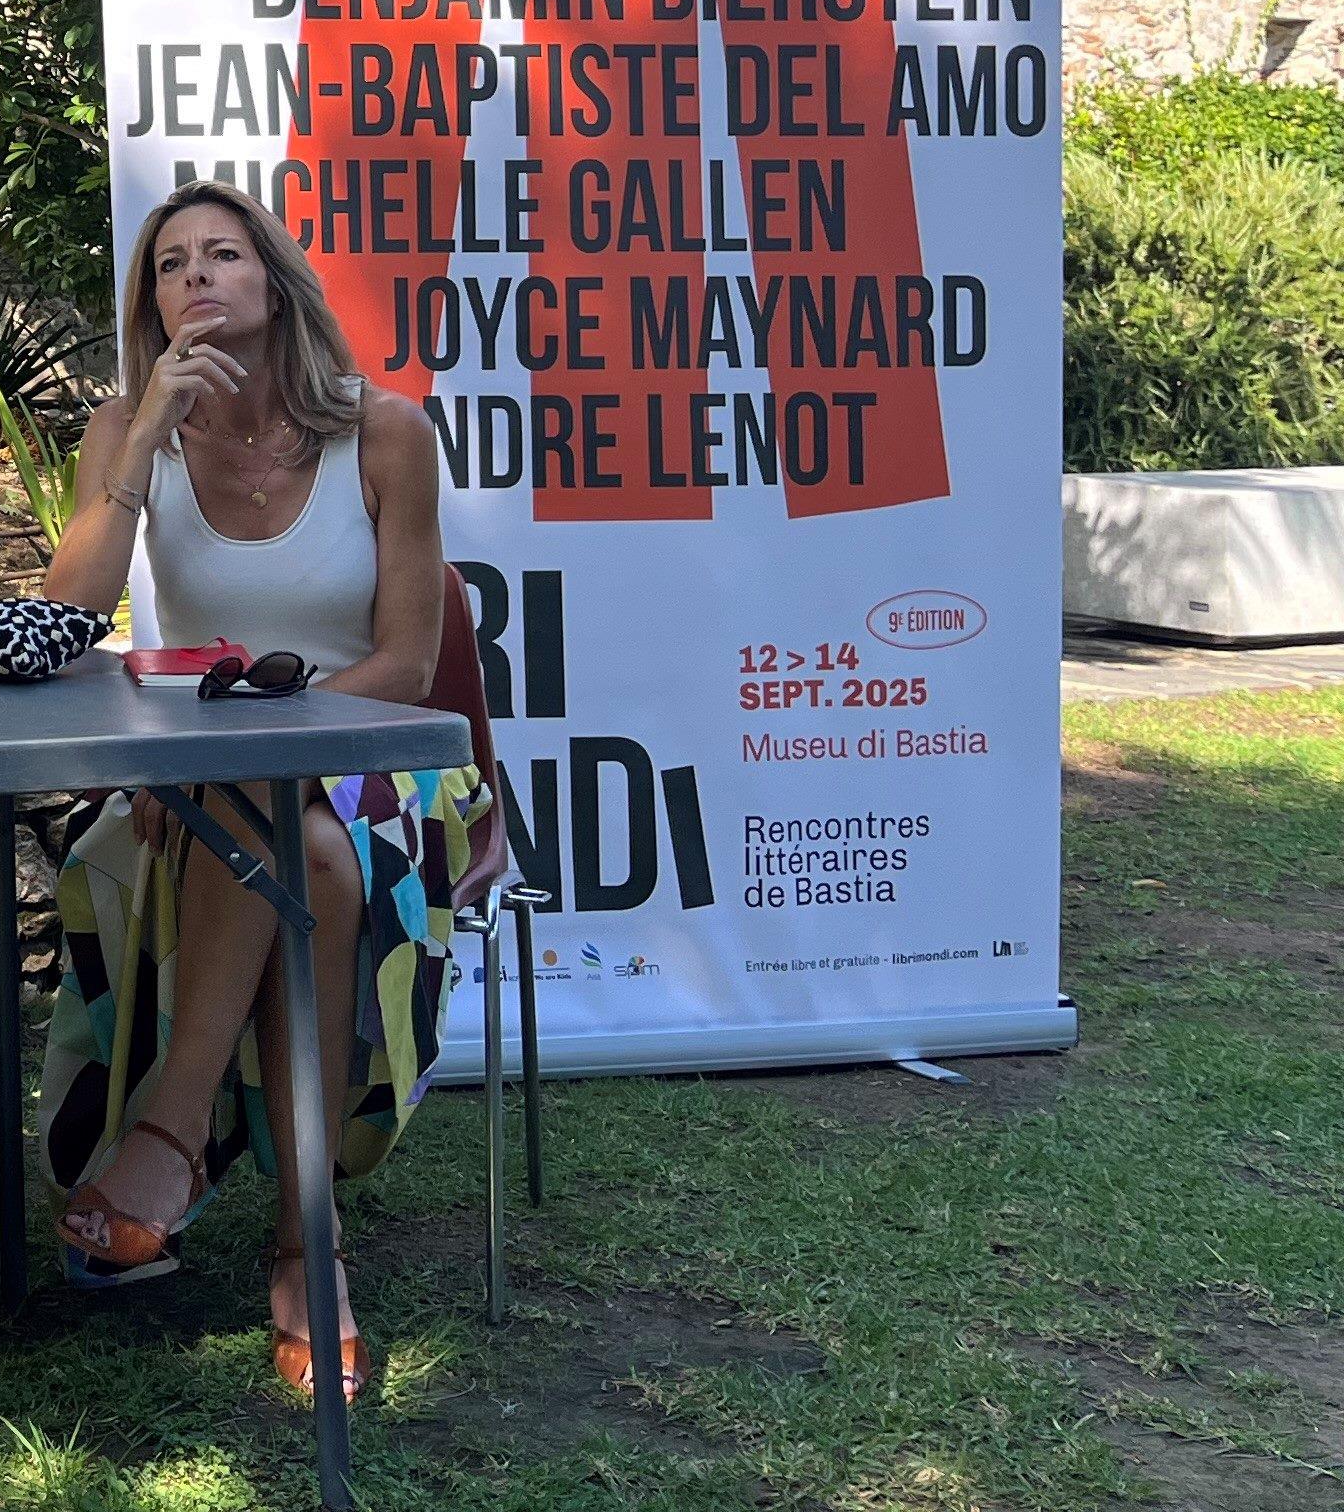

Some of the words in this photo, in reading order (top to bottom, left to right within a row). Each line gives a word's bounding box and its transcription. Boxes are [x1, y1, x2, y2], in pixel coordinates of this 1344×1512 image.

[126, 43, 702, 138] JEAN-BAPTISTE
[727, 43, 864, 137] DEL
[887, 43, 1047, 137] AMO
[569, 159, 846, 254] GALLEN
[384, 276, 604, 372] JOYCE
[631, 275, 986, 369] MAYNARD
[648, 391, 877, 488] LENOT
[908, 607, 965, 632] ÉDITION
[739, 644, 779, 674] 12
[815, 642, 860, 672] 14
[739, 678, 834, 711] SEPT.
[841, 677, 928, 708] 2025
[742, 732, 849, 763] Museu
[857, 728, 886, 759] di
[895, 724, 990, 758] Bastia
[744, 811, 930, 845] Rencontres
[744, 840, 908, 877] littéraires
[744, 877, 786, 909] de
[795, 872, 897, 907] Bastia
[745, 958, 788, 973] Entrée
[791, 957, 817, 972] libre
[818, 956, 831, 969] et
[833, 954, 881, 971] gratuite
[891, 947, 980, 966] librimondi.com
